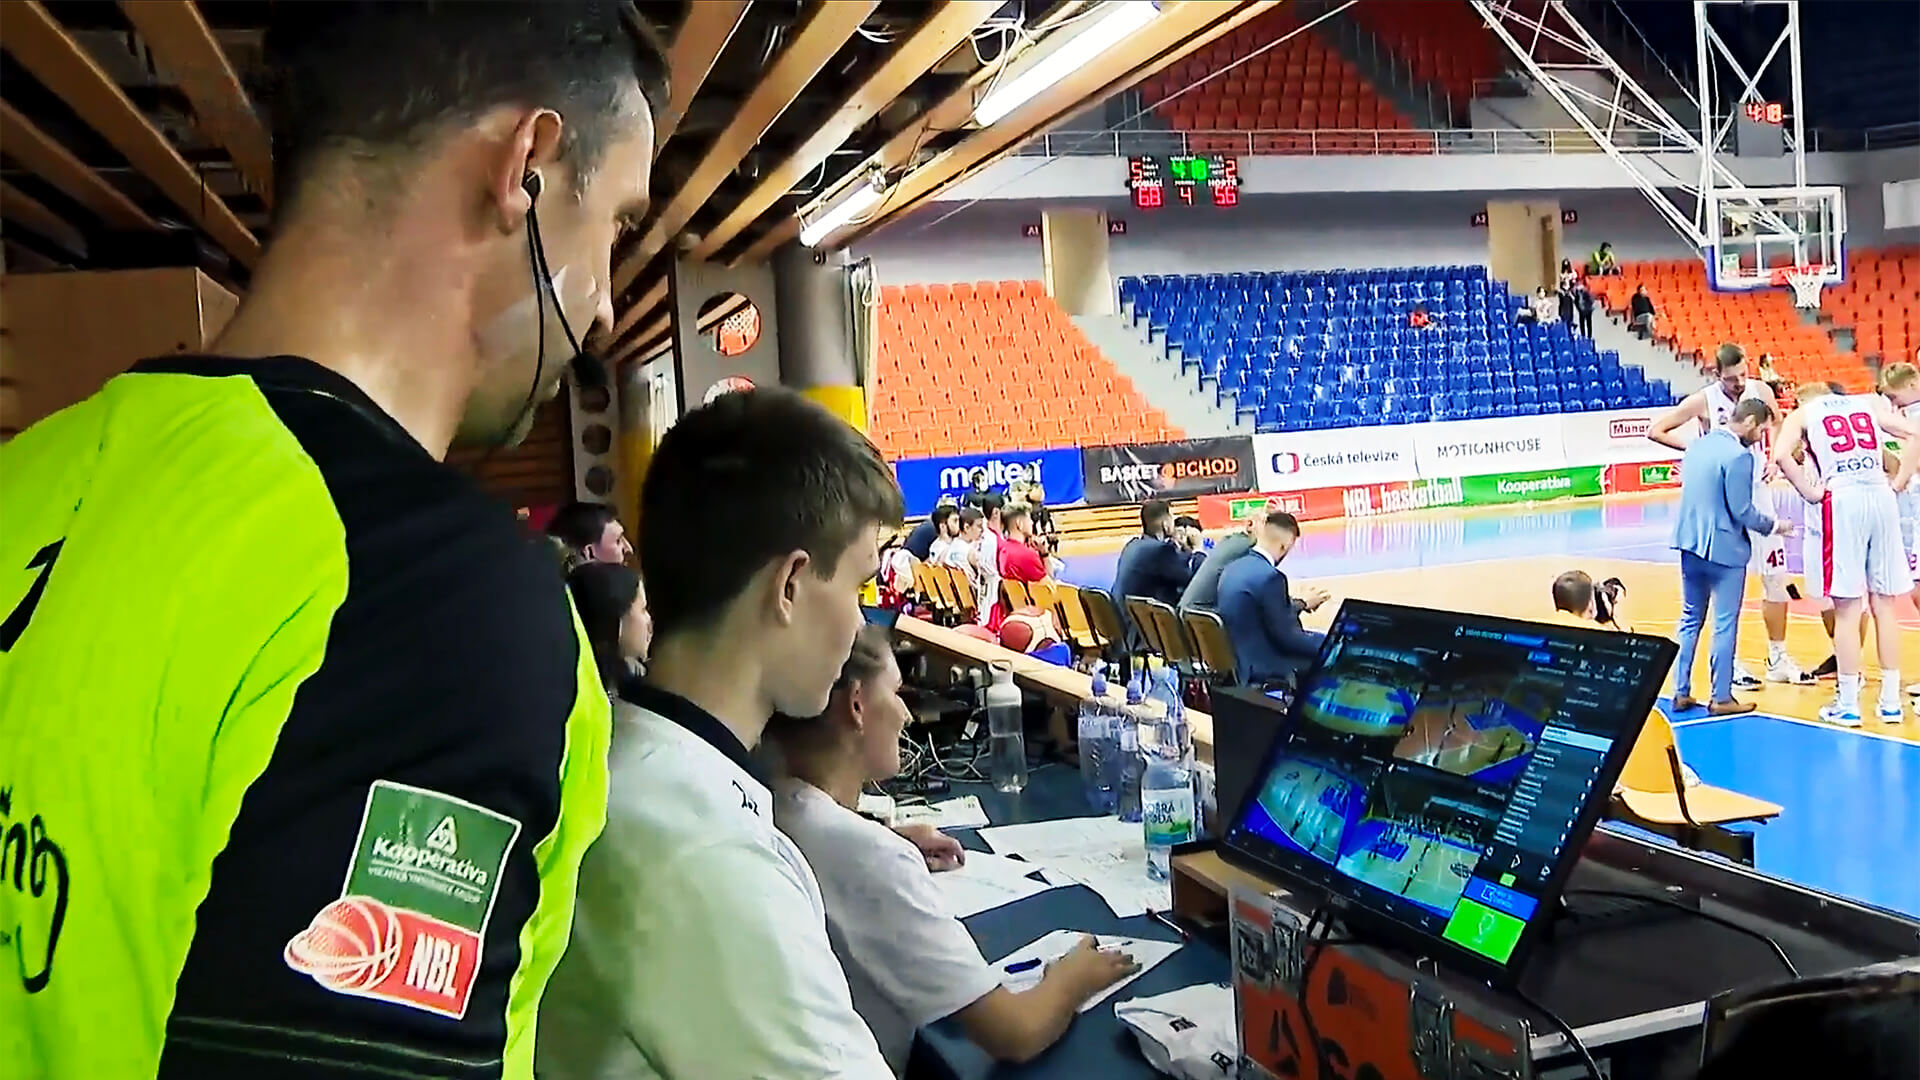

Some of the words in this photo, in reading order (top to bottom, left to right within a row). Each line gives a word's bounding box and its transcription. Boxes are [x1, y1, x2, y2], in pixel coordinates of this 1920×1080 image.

[1179, 186, 1192, 206] 4
[1822, 411, 1878, 453] 99
[1347, 449, 1400, 465] televize
[1437, 437, 1542, 458] MOTIONHOUSE
[1497, 475, 1572, 495] Kooperativa
[371, 836, 489, 886] Kooperativa
[405, 932, 462, 999] NBL
